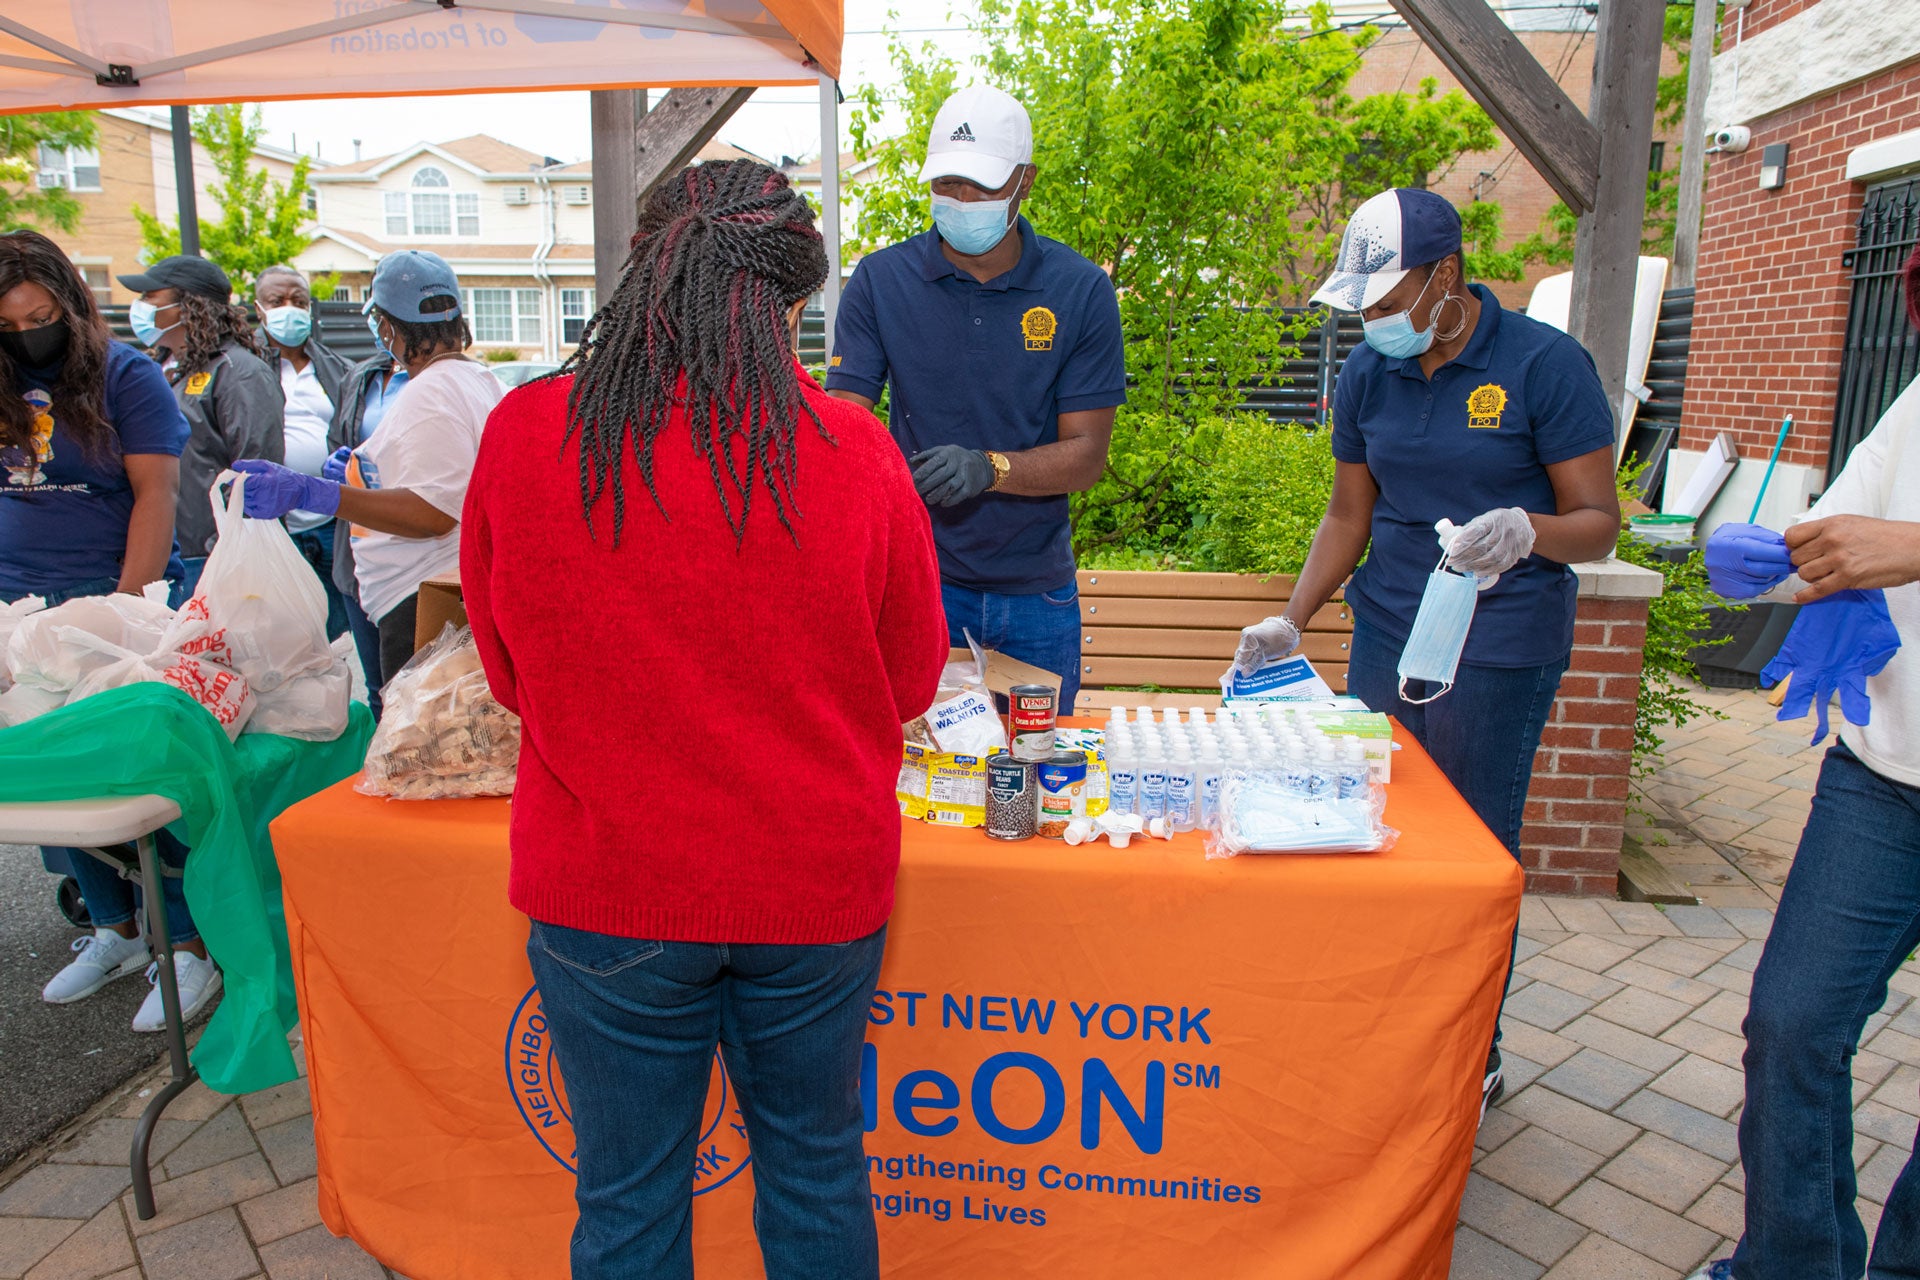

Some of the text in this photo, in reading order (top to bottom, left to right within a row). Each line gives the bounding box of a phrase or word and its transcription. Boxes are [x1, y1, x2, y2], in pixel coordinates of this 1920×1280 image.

[950, 134, 976, 142] adidas
[1032, 340, 1046, 348] PO
[1477, 417, 1491, 426] PO
[59, 483, 88, 491] LAUREN
[937, 698, 976, 718] SHELLED
[1022, 698, 1050, 708] VENICE
[936, 703, 987, 729] WALNUTS
[1015, 717, 1029, 725] Cream
[938, 767, 970, 776] TOASTED
[988, 767, 1002, 776] BLACK
[868, 990, 1212, 1045] ST NEW YORK
[520, 1001, 559, 1128] NEIGHBO
[1172, 1062, 1221, 1089] SM
[866, 1153, 1262, 1204] ngthening Communities
[871, 1191, 1047, 1227] nging Lives
